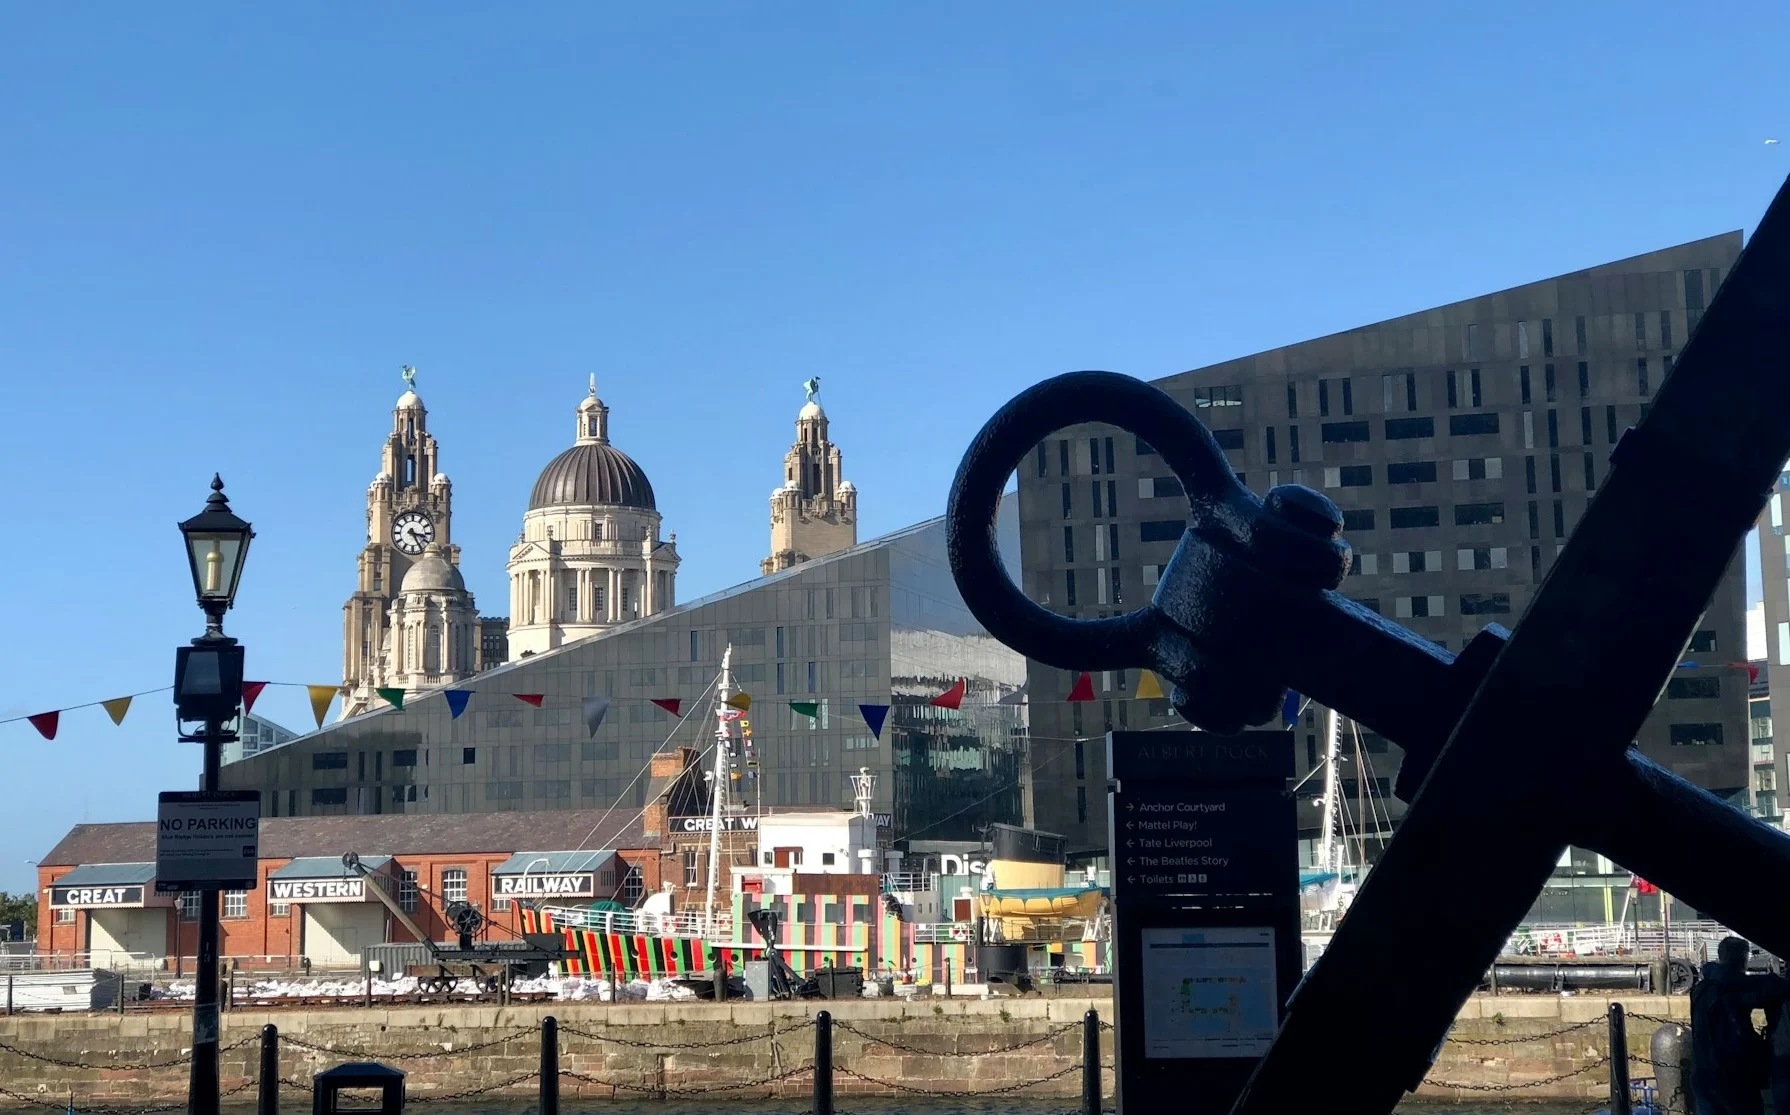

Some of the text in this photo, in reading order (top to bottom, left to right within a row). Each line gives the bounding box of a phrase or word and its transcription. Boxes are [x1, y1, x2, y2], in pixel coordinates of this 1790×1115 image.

[1139, 802, 1226, 813] Anchor Courtyard
[160, 817, 257, 830] NO PARKING
[1138, 820, 1198, 831] Mattel Play!
[1139, 838, 1213, 849] Tate Liverpool
[1139, 856, 1229, 867] The Beatles Story
[1140, 874, 1174, 884] Toilets
[66, 876, 584, 905] GREAT WESTERN RAILWAY
